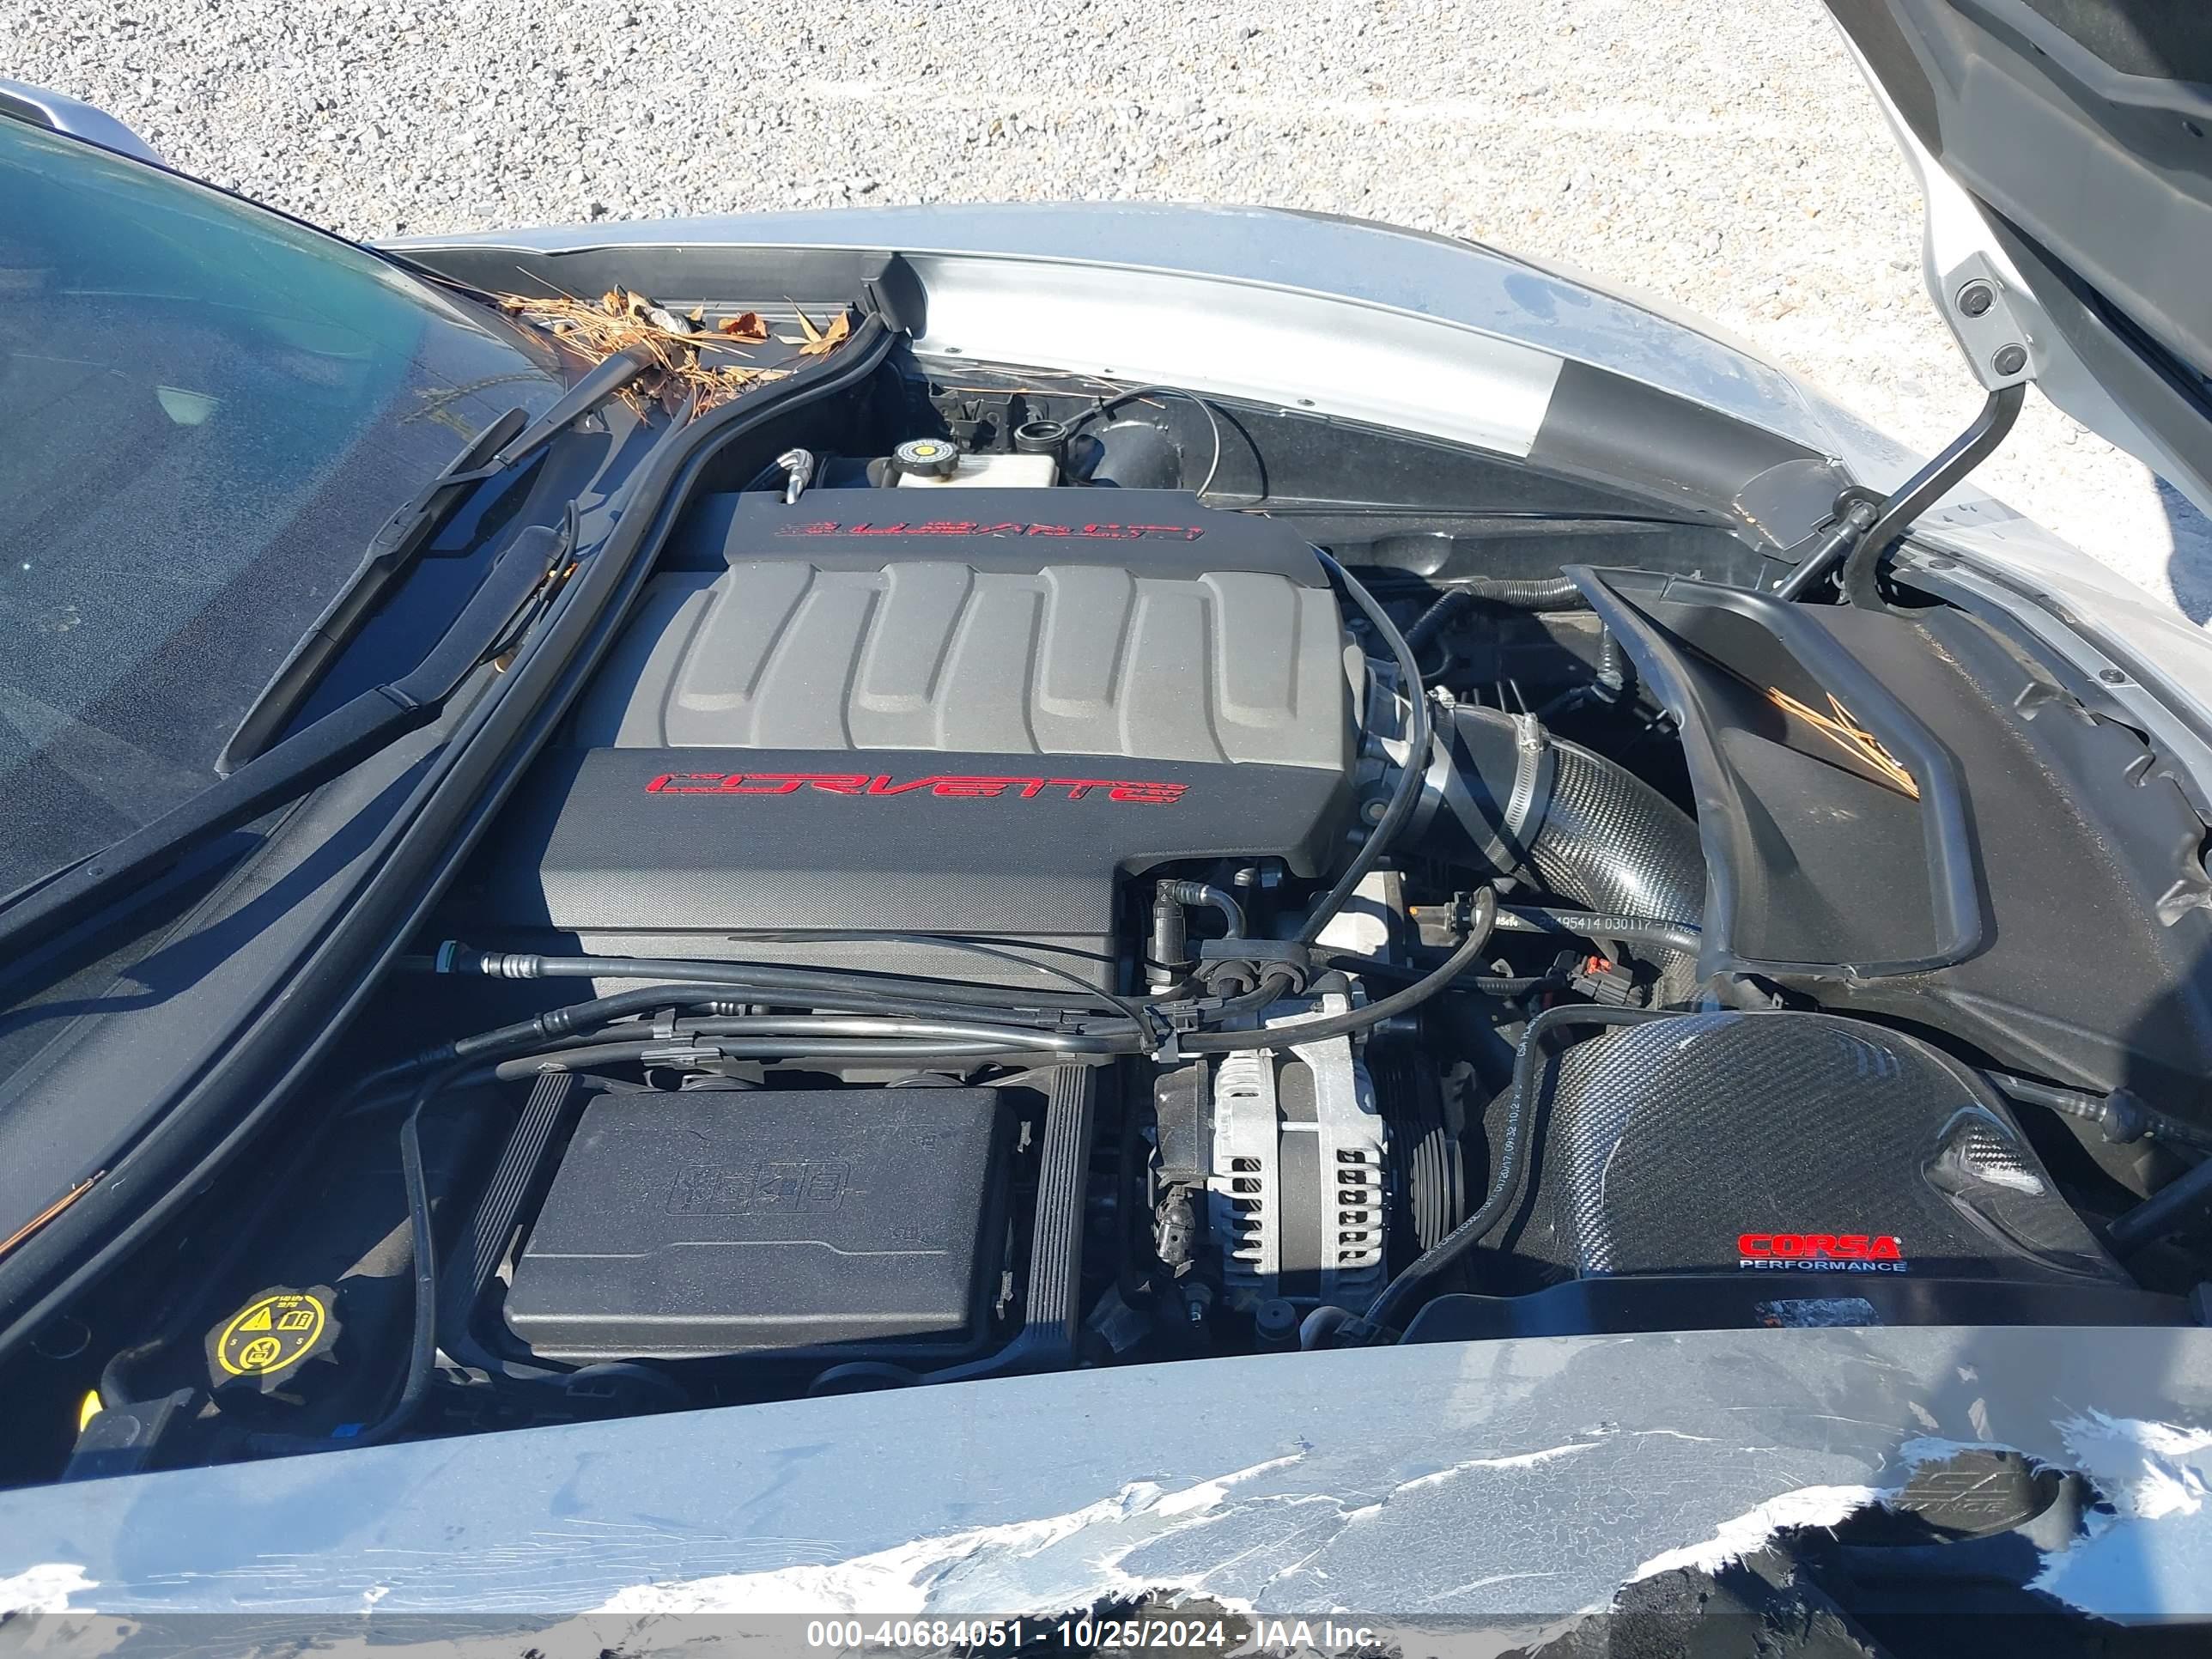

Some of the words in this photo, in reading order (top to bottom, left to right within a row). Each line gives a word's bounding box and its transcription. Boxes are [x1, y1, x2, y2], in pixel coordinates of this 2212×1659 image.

[645, 772, 1191, 804] CORVETTE
[1604, 917, 1651, 933] 030117
[1509, 1103, 1522, 1122] 10,2
[1504, 1126, 1517, 1152] 09:32
[1740, 1260, 1907, 1273] PERFORMANCE
